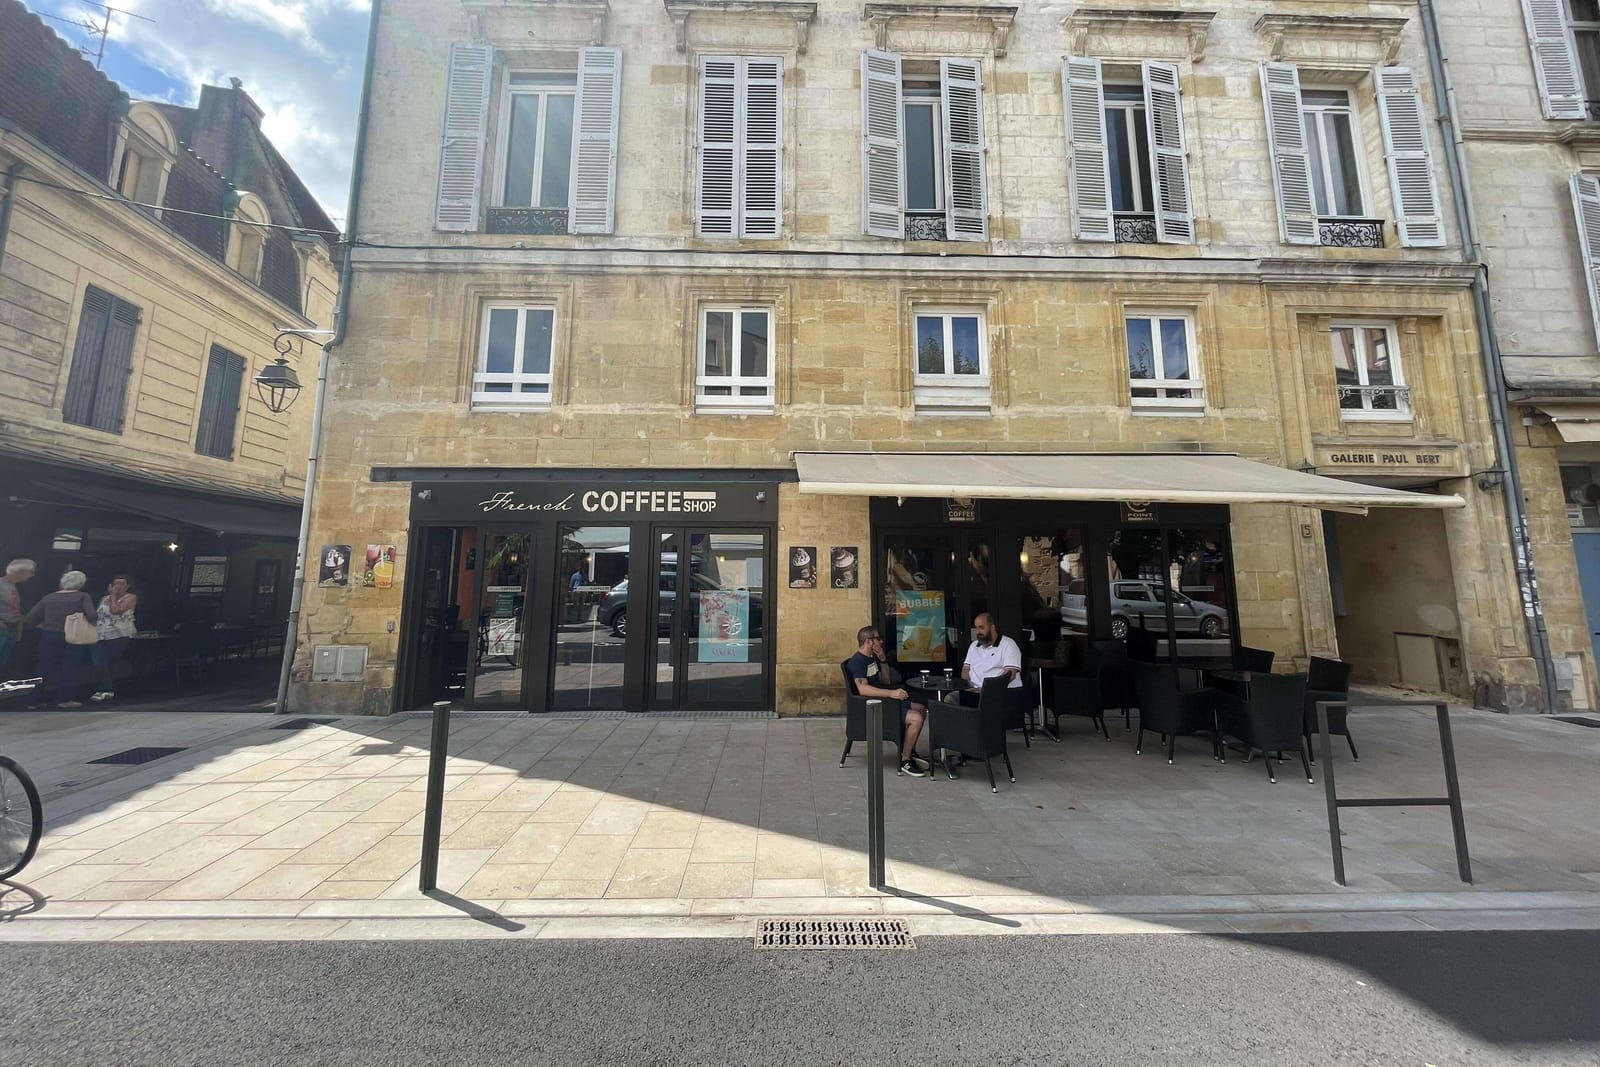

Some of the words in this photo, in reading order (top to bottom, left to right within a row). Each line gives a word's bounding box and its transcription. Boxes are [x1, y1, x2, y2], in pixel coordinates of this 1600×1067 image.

[1331, 454, 1375, 464] GALERIE
[1382, 454, 1409, 464] PAUL
[1416, 454, 1440, 464] BERT
[479, 491, 575, 512] French
[582, 490, 681, 512] COFFEE
[683, 500, 717, 513] SHOP
